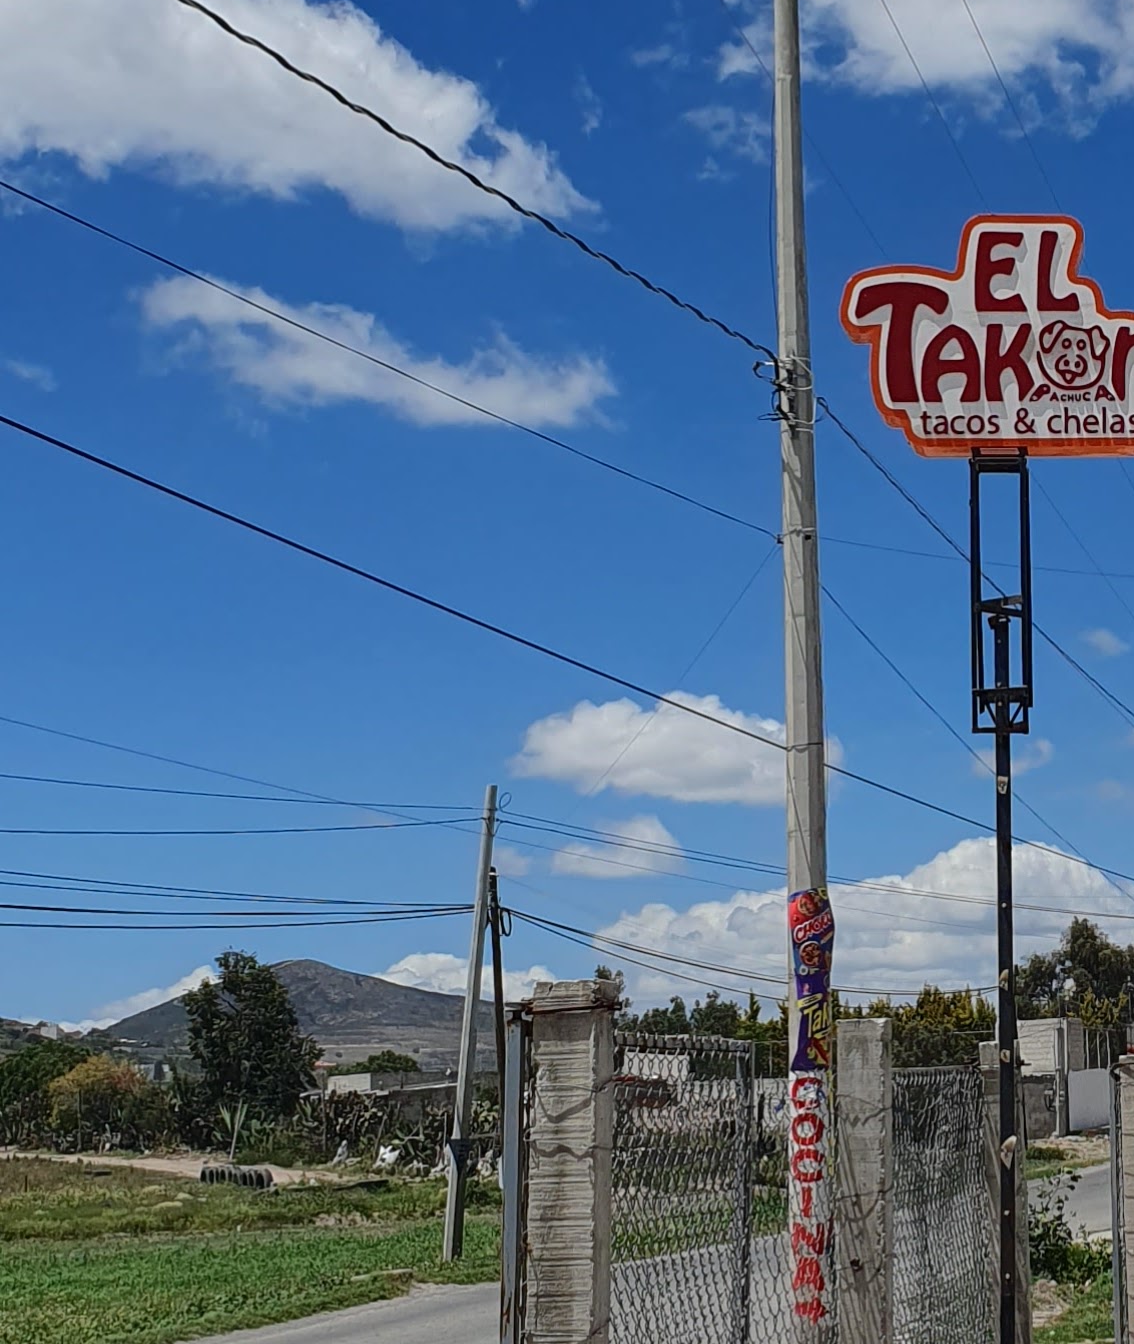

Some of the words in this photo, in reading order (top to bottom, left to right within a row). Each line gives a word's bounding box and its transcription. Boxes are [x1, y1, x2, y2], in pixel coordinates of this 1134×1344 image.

[974, 230, 1080, 312] EL
[920, 410, 1000, 435] tacos
[1013, 407, 1036, 434] &
